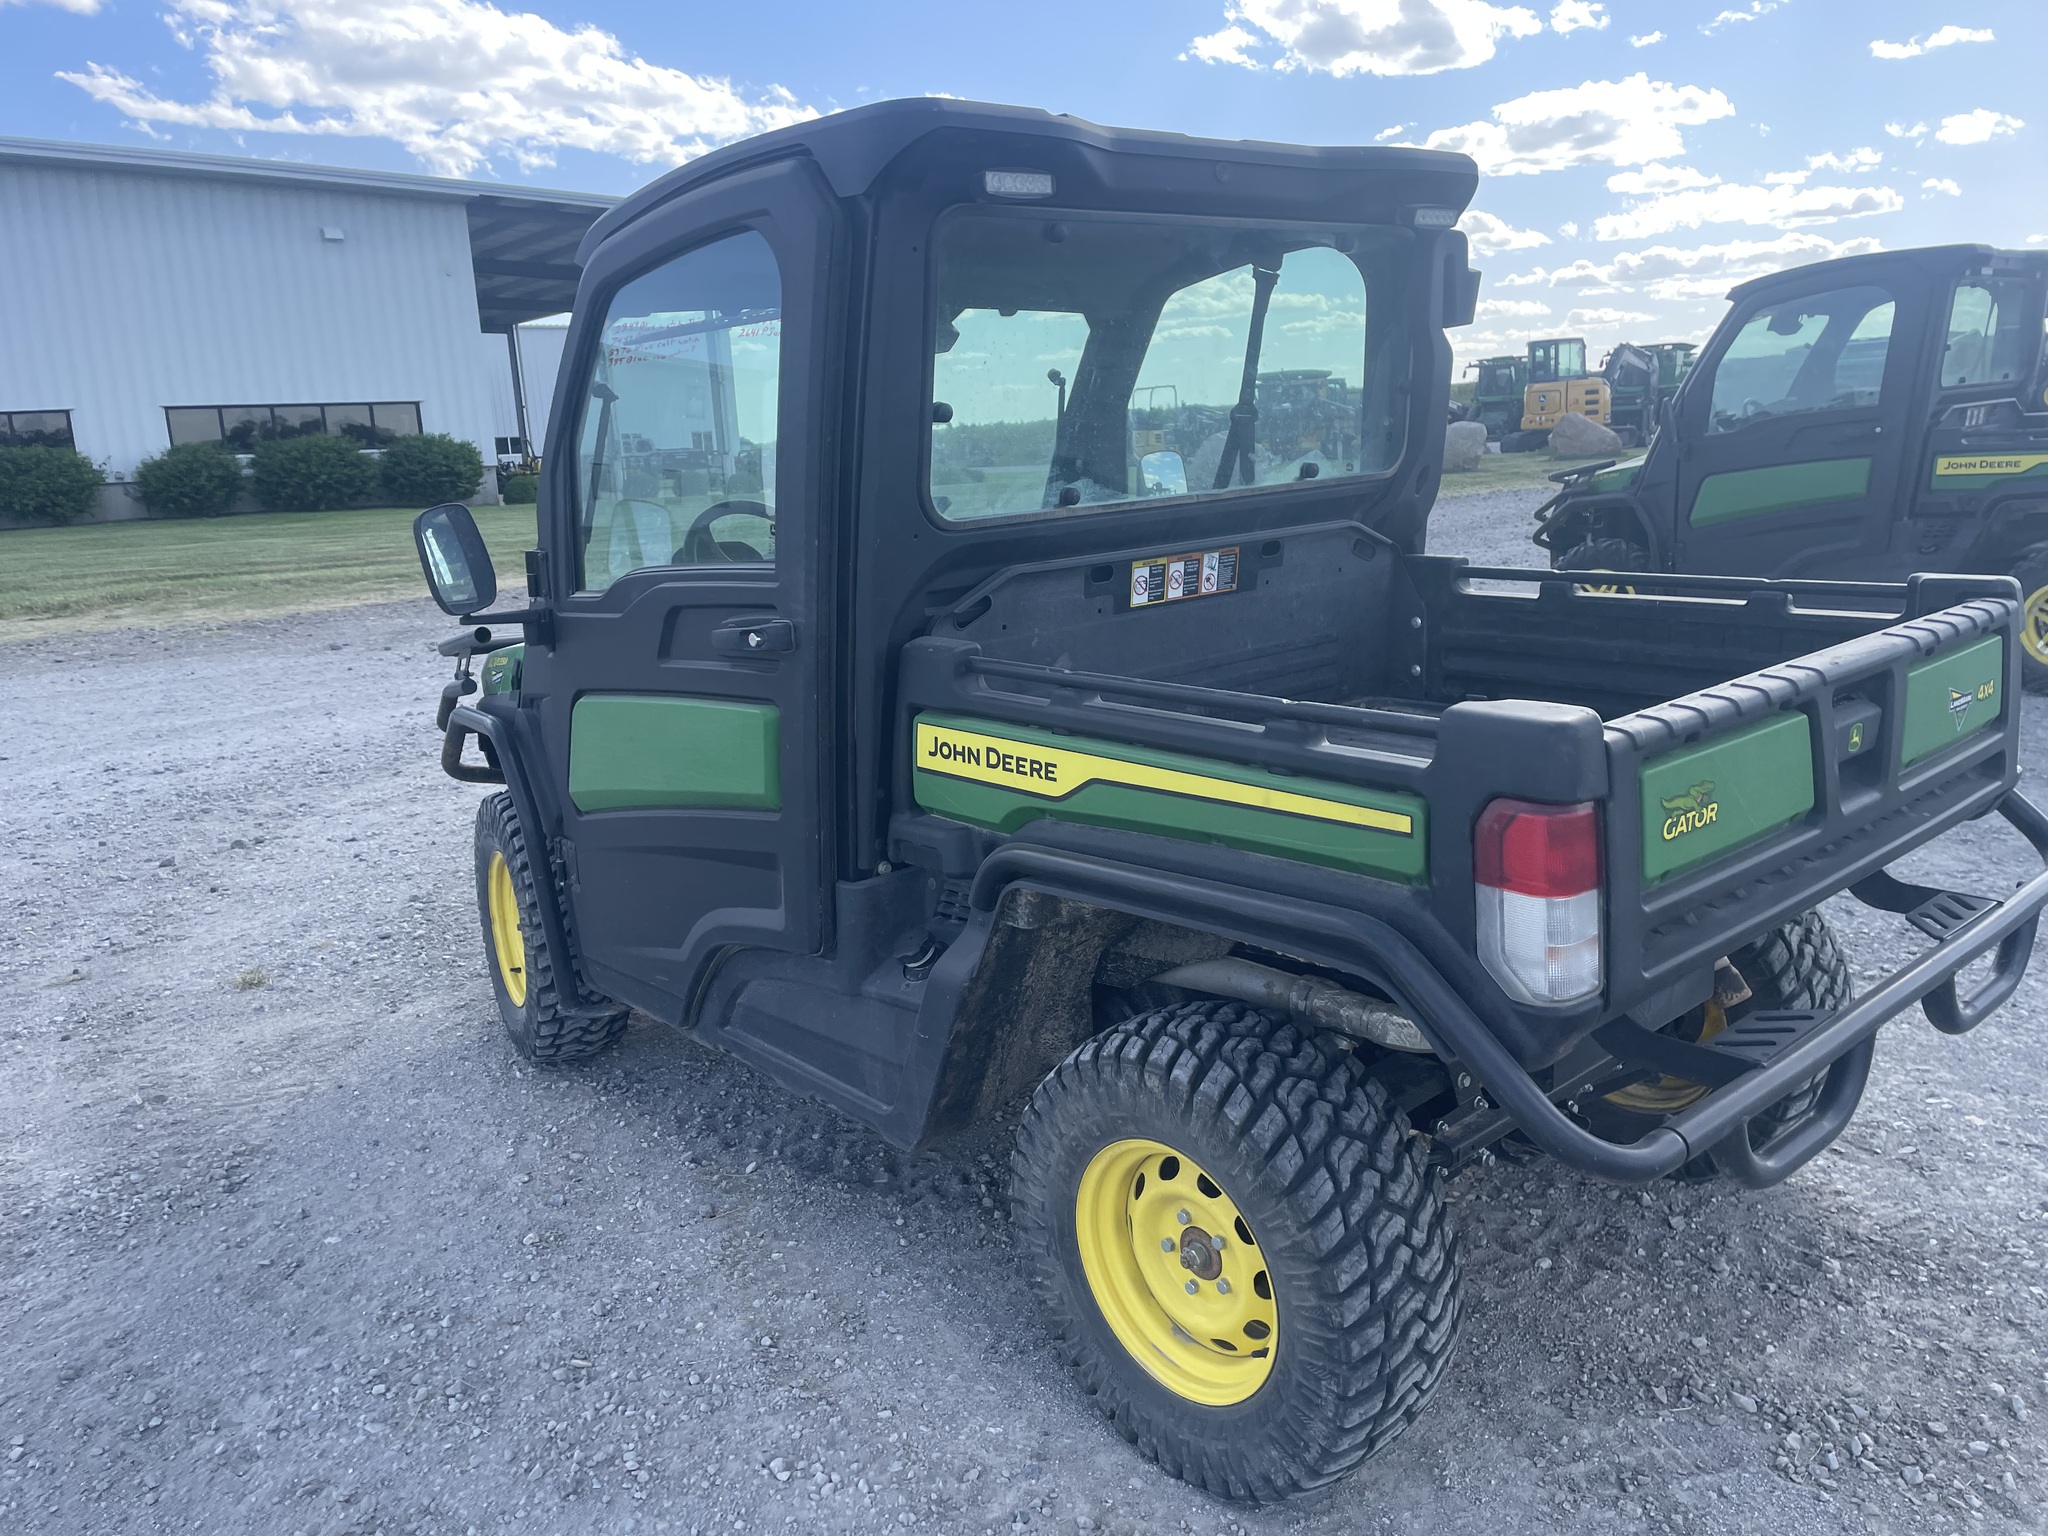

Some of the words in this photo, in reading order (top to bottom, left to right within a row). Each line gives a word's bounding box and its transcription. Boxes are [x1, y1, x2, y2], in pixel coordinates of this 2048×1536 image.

[1943, 461, 1977, 470] JOHN
[1979, 460, 2022, 469] DEERE
[928, 736, 981, 767] JOHN
[985, 746, 1058, 782] DEERE
[1662, 802, 1719, 841] GATOR
